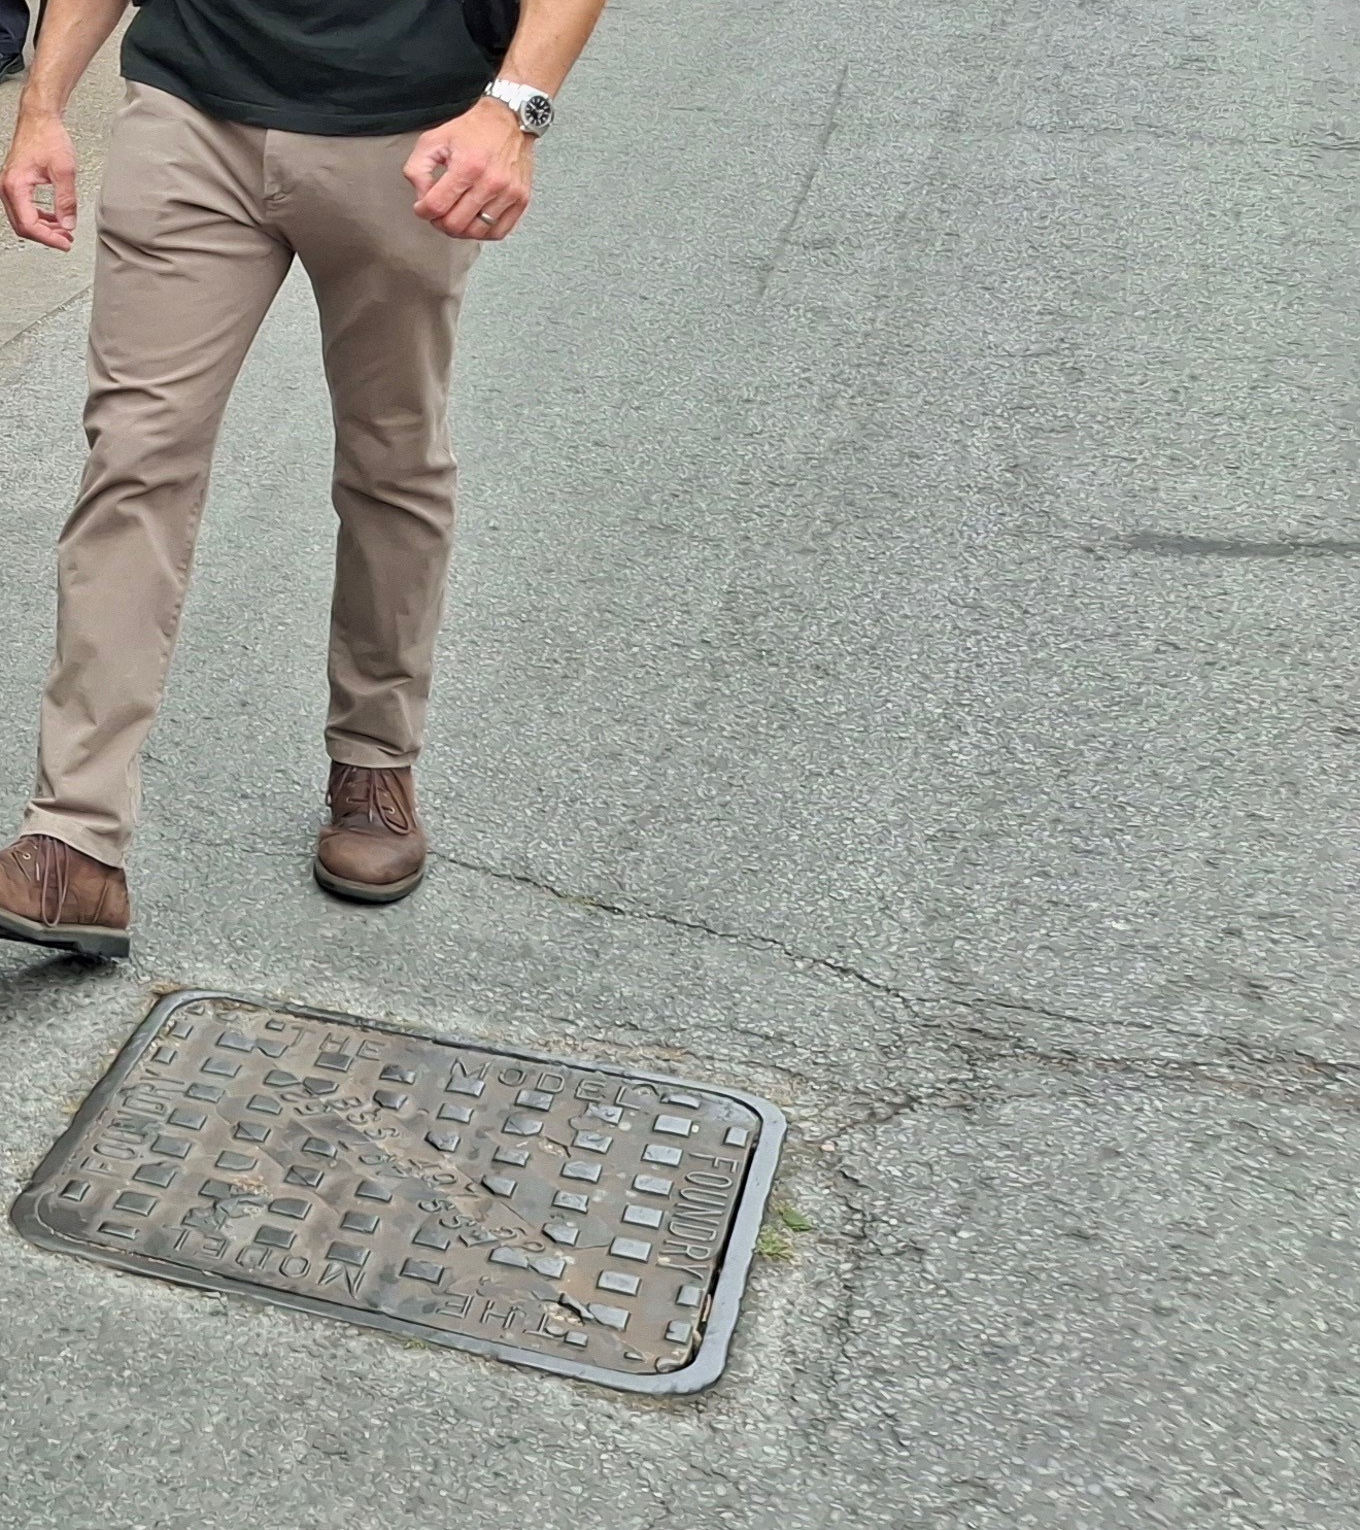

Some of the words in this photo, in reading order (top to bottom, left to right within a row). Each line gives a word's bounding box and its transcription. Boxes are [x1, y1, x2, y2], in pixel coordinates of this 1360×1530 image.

[291, 1025, 386, 1062] THE
[448, 1057, 642, 1111] MODEL
[655, 1151, 740, 1282] FOUNDRY
[172, 1227, 368, 1301] MODEL
[434, 1289, 556, 1340] THE
